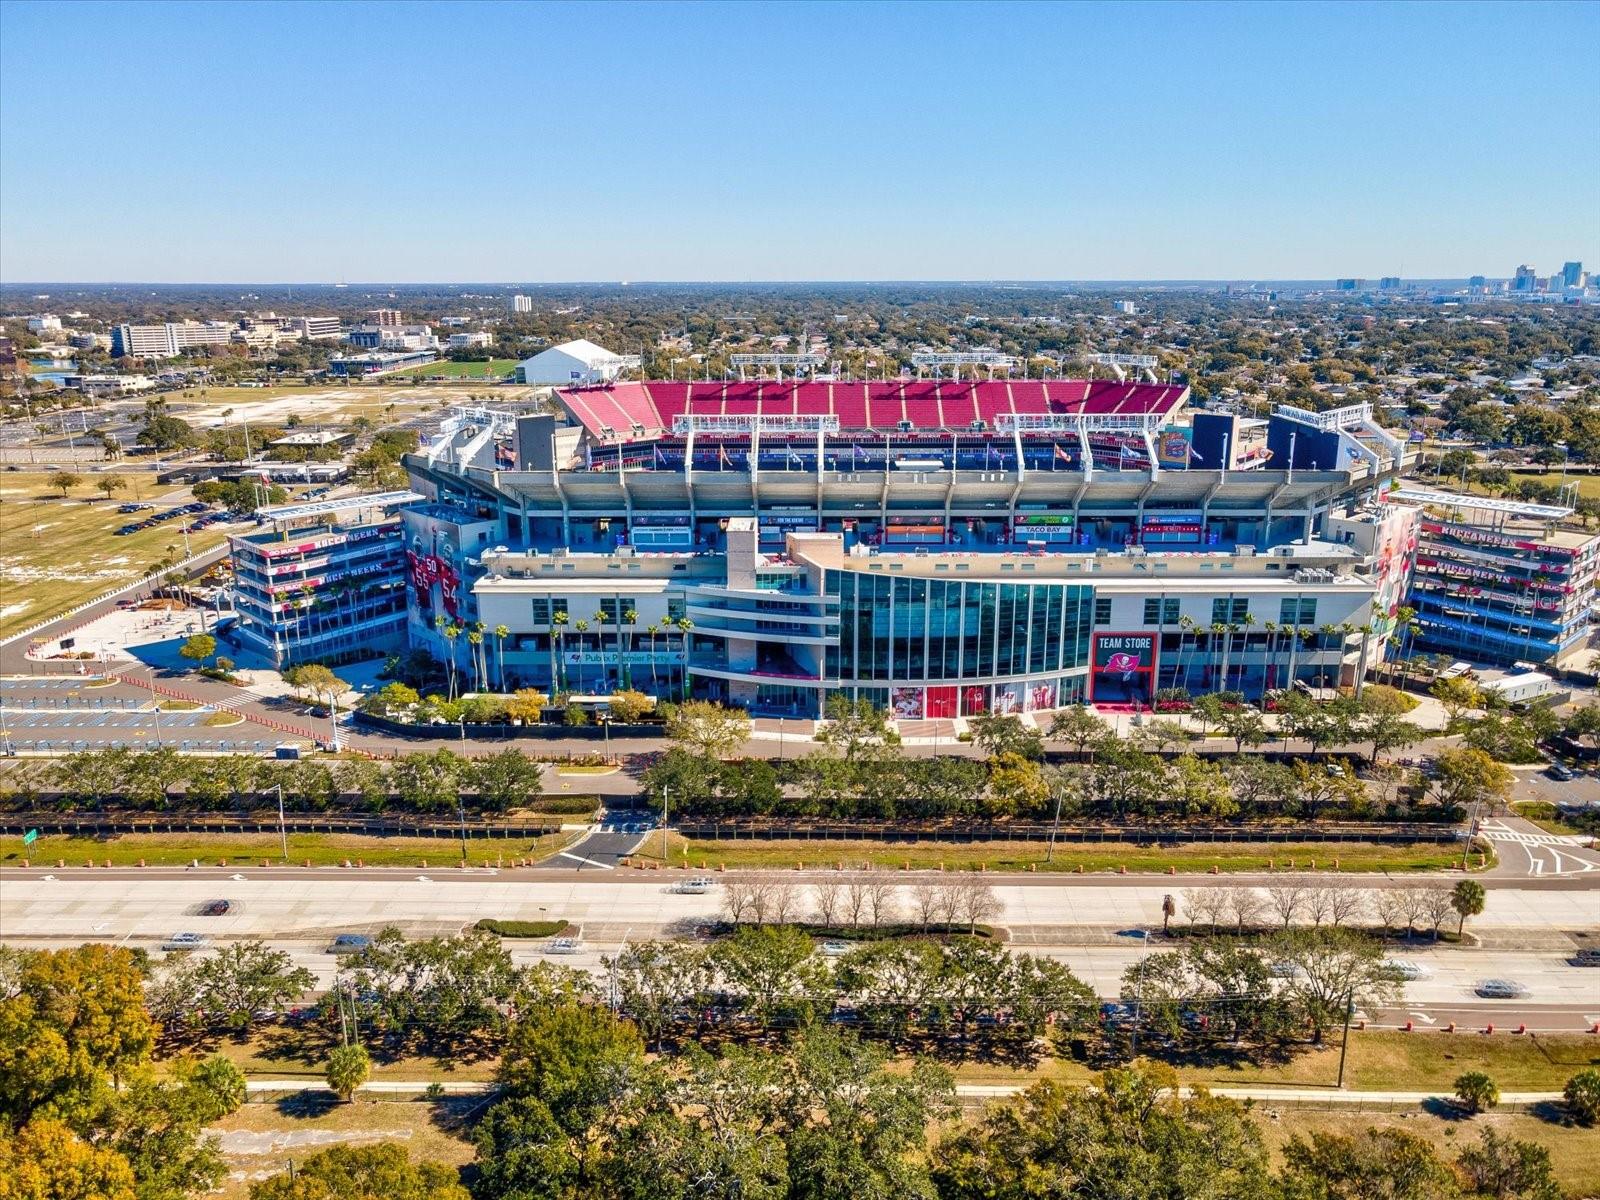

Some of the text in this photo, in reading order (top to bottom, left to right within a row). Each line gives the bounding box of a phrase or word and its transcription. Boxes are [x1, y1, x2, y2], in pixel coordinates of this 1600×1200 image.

[1441, 526, 1517, 547] BUCCANEERS
[426, 558, 437, 573] 50
[416, 567, 429, 590] 55
[443, 578, 457, 603] 54
[1543, 584, 1565, 592] BUCS
[1100, 638, 1151, 648] TEAM STORE
[585, 654, 611, 662] Pubix
[612, 654, 644, 662] Pemier
